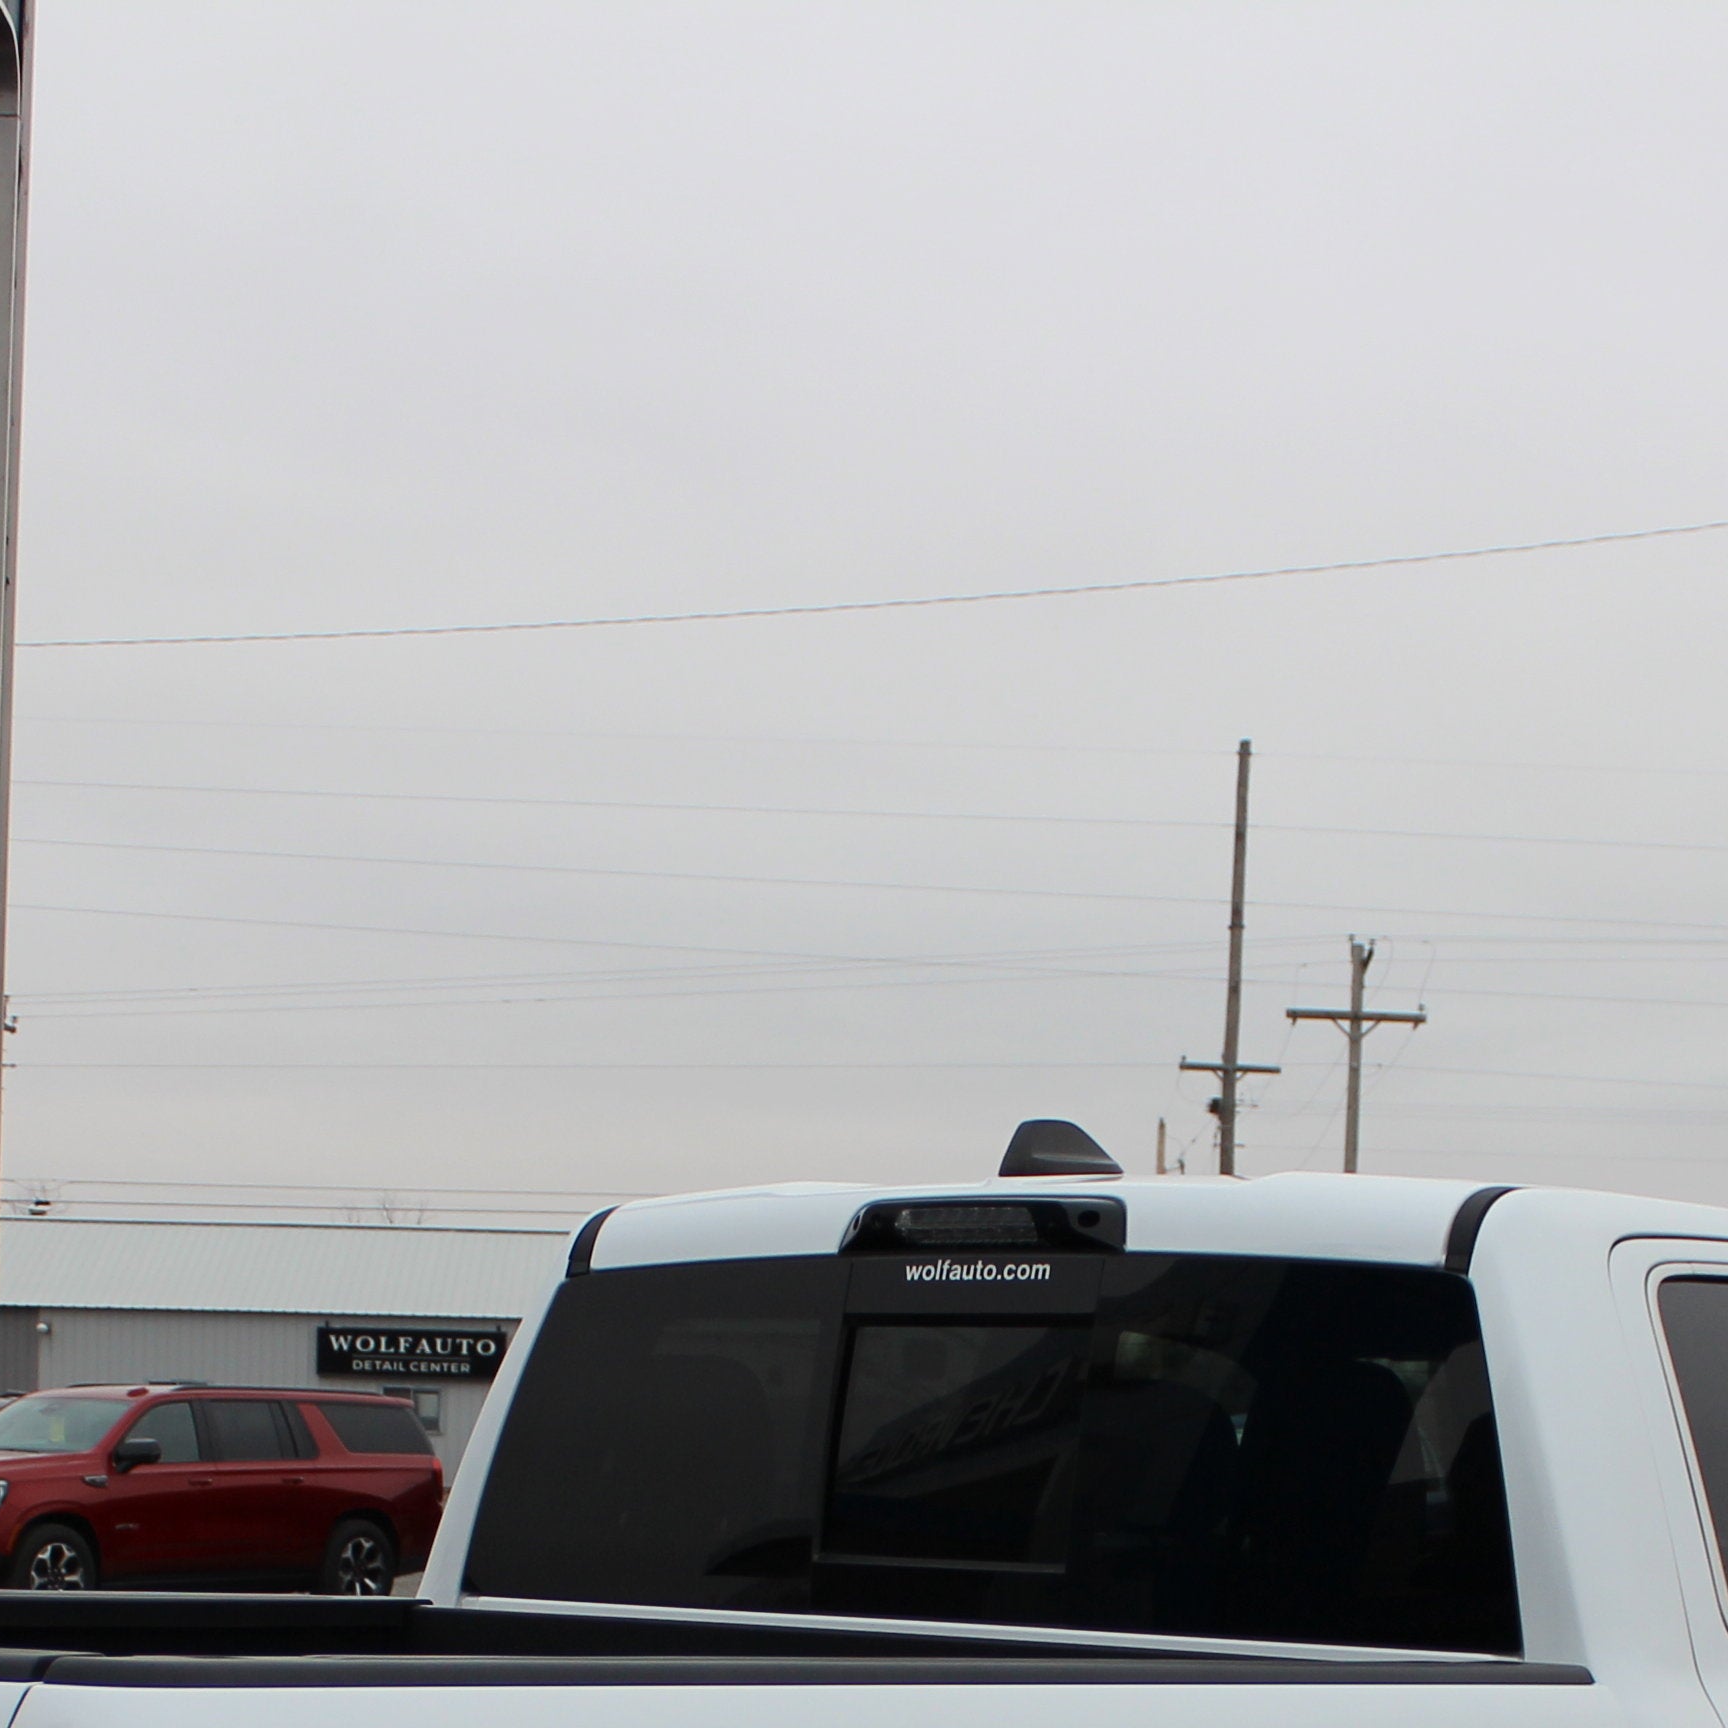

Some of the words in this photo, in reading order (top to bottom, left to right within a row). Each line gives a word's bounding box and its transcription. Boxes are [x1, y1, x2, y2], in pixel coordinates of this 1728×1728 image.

[905, 1259, 1051, 1281] wolfauto.com
[328, 1334, 496, 1356] WOLFAUTO
[352, 1359, 406, 1372] DETAIL
[409, 1361, 471, 1373] CENTER
